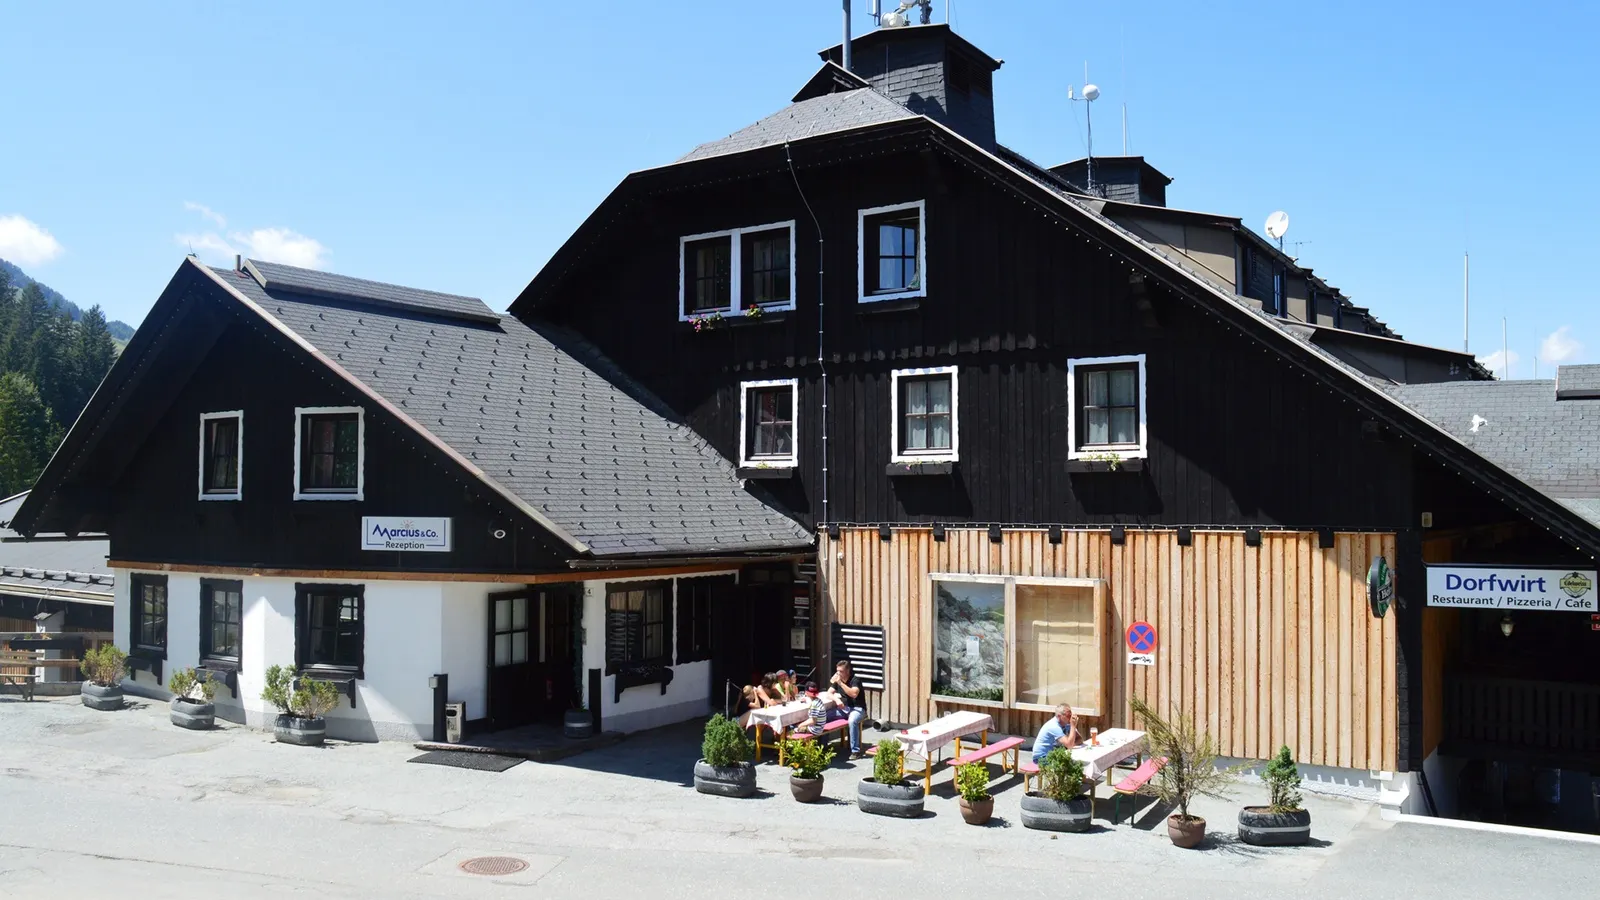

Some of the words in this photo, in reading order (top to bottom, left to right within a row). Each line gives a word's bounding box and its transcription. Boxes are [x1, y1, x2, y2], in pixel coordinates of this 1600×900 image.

[385, 541, 425, 549] Rezeption
[1446, 574, 1546, 592] Dorfwirt
[1432, 595, 1494, 605] Restaurant
[1507, 597, 1552, 607] Pizzeria
[1565, 599, 1592, 608] Cafe
